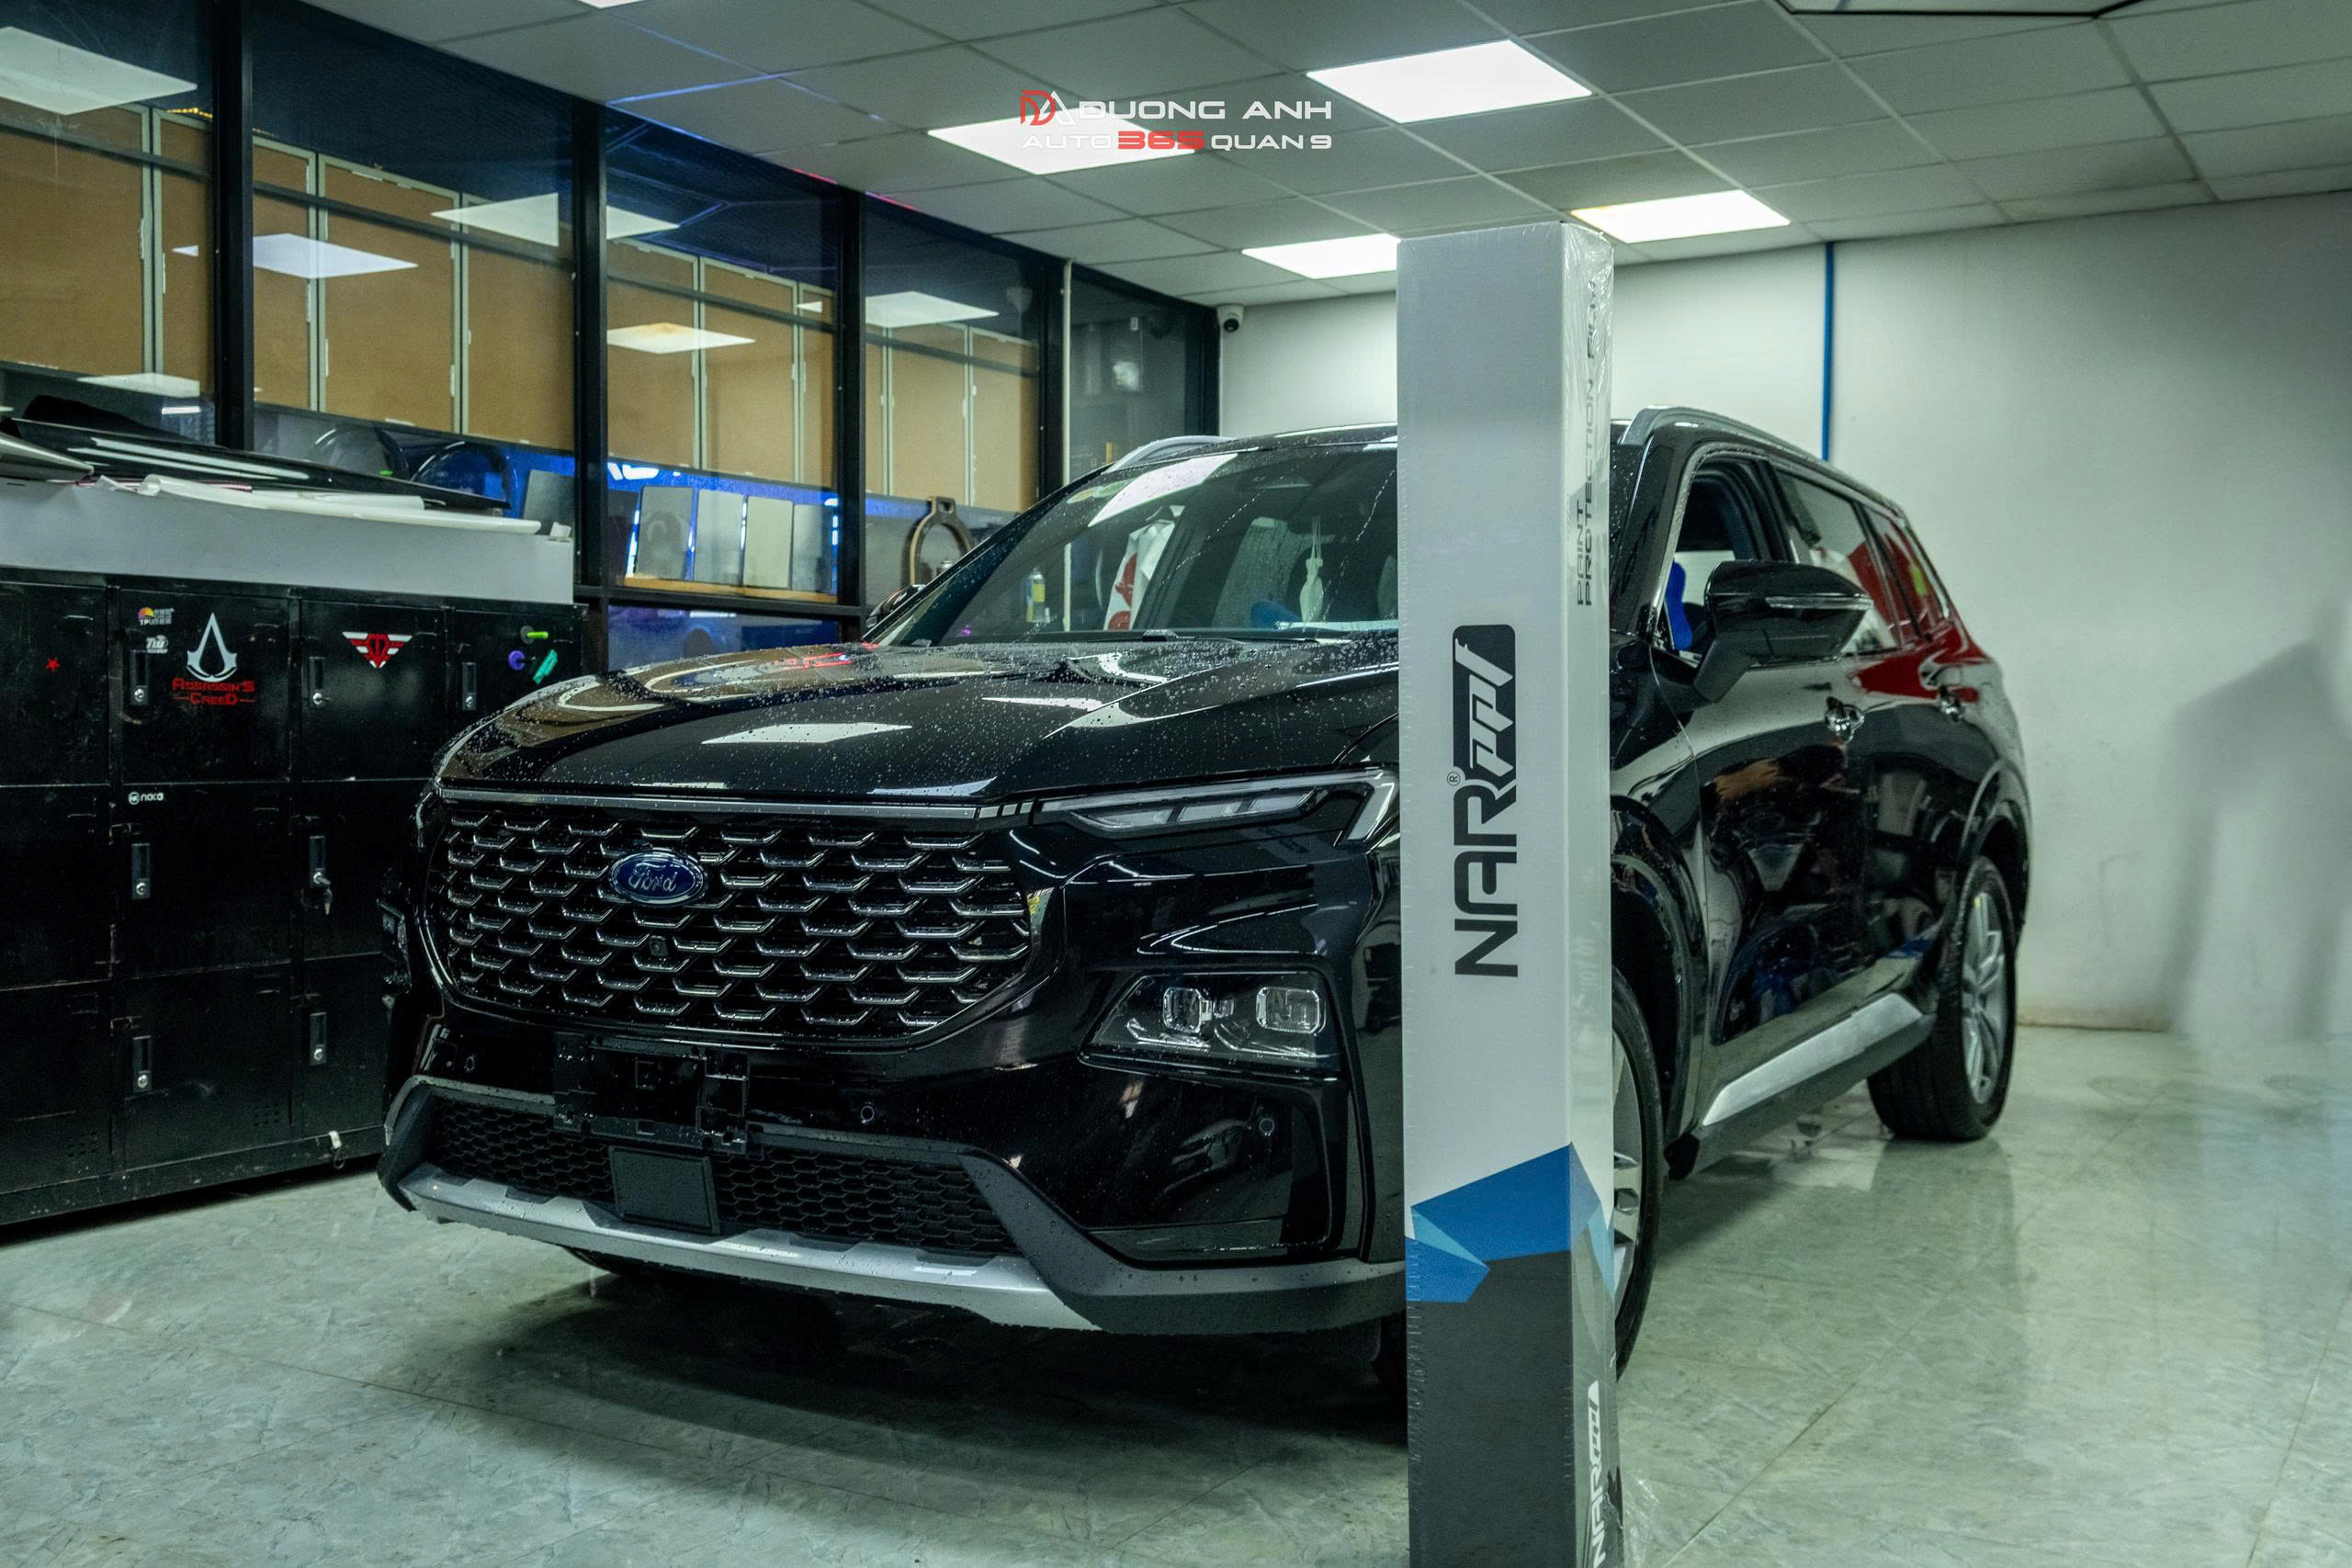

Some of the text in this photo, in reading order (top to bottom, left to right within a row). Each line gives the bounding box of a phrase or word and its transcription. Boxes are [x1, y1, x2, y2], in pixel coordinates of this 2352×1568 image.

[1585, 378, 1594, 606] PROTECTION
[628, 863, 678, 892] Ford
[1453, 784, 1519, 977] NAR
